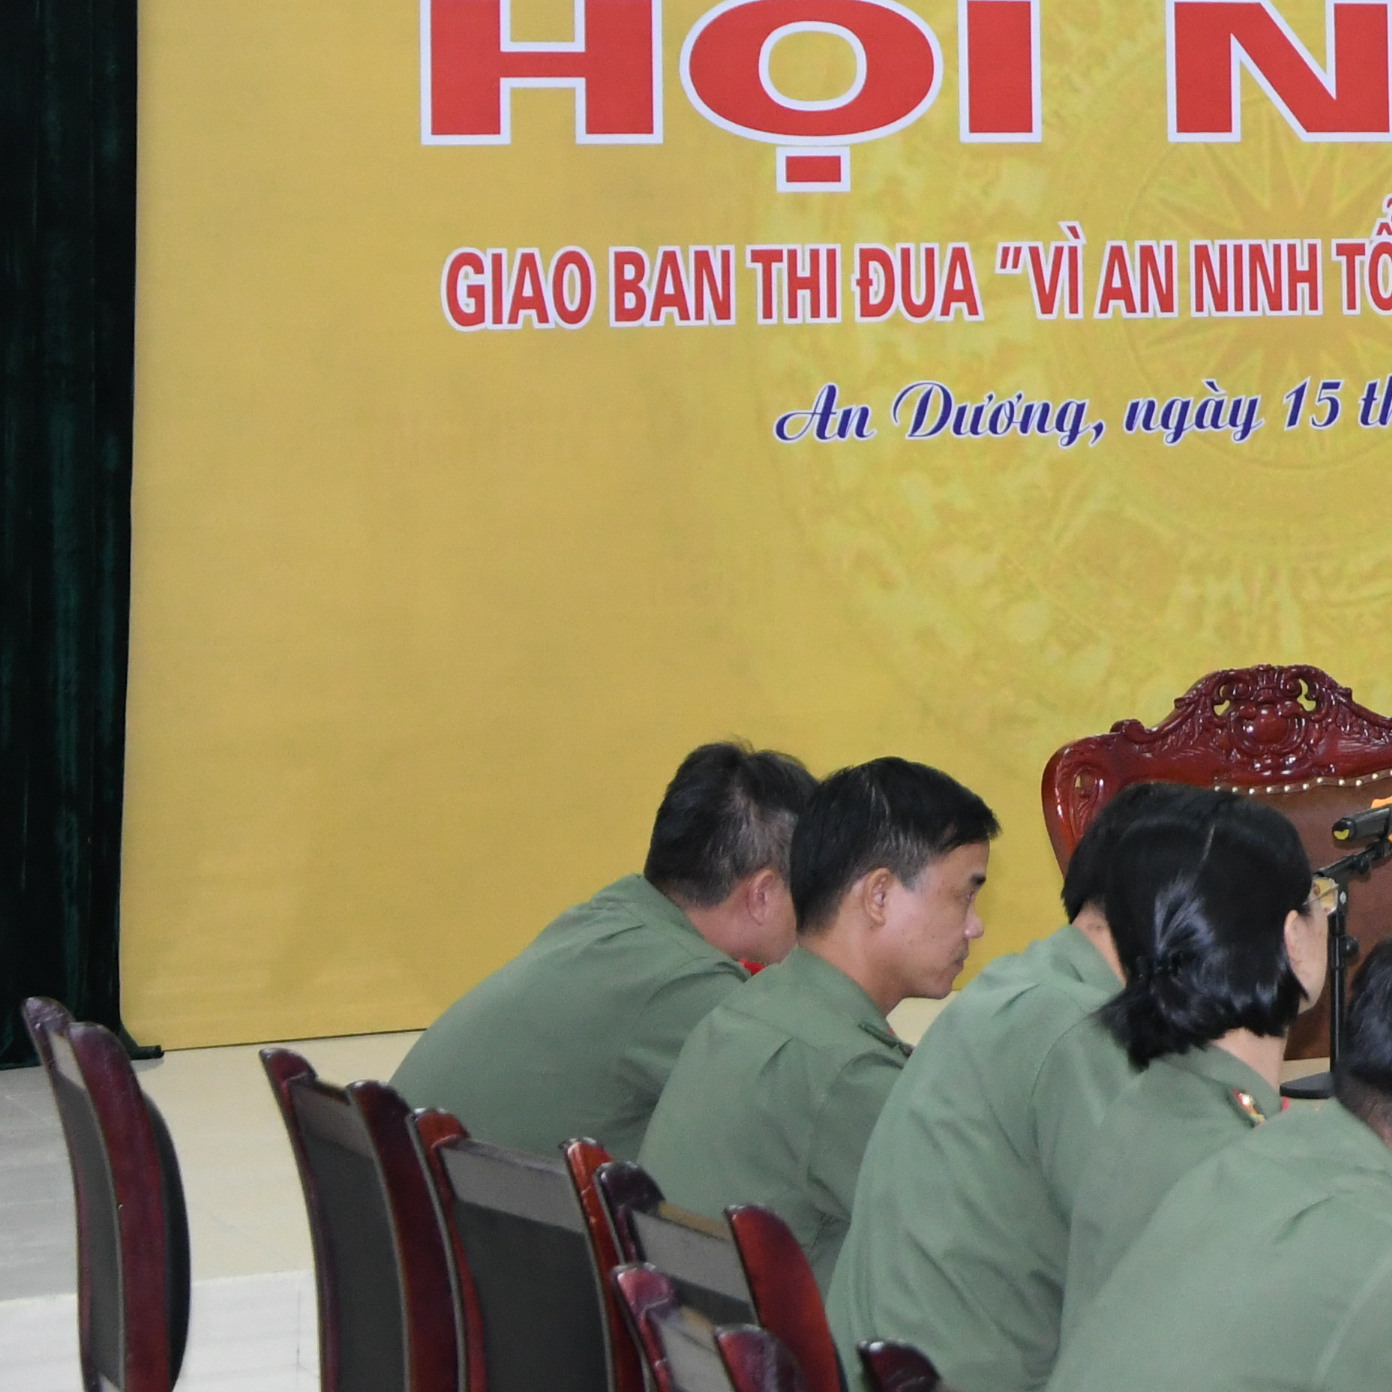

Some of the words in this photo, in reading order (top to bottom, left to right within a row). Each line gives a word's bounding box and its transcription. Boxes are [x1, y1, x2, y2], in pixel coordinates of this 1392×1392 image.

[442, 248, 595, 329] GIAO
[611, 246, 734, 327] BAN
[749, 244, 839, 324] THI
[855, 242, 981, 322] ĐUA
[1099, 242, 1176, 318] AN
[1192, 239, 1321, 315] NINH
[775, 384, 874, 442] An
[894, 382, 1106, 447] Dương,
[1124, 379, 1262, 440] ngày
[1284, 378, 1341, 431] 15
